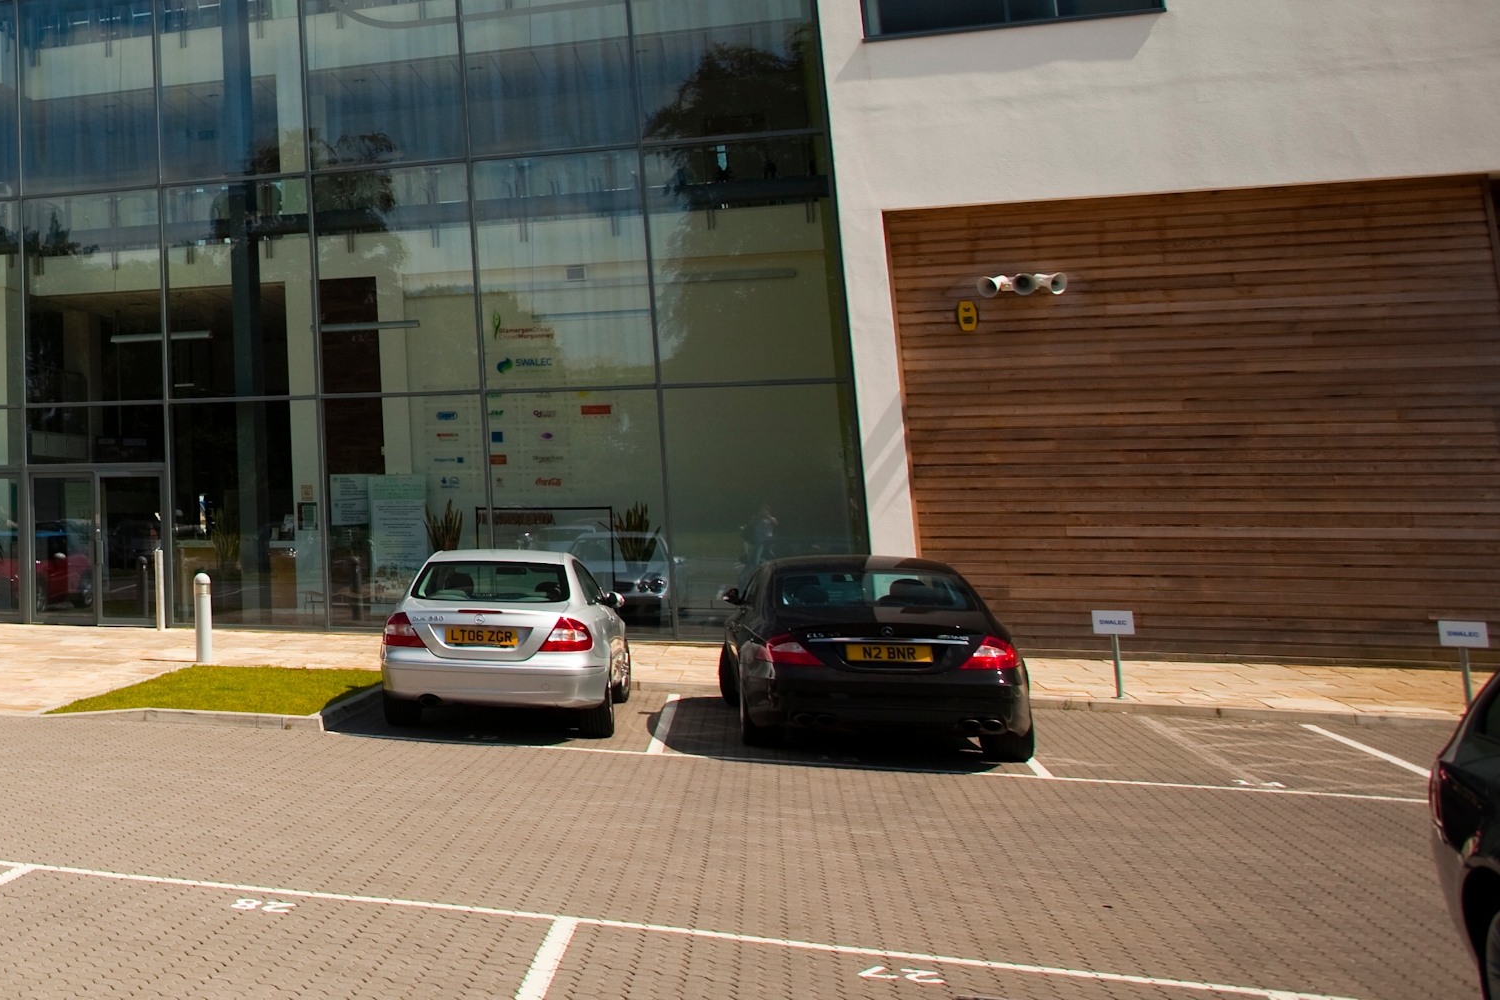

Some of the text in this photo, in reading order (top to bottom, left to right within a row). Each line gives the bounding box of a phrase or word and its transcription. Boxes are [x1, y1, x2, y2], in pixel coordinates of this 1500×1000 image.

[515, 357, 553, 367] SWALEC
[451, 629, 513, 643] LT06 ZGR
[1446, 630, 1480, 638] SWALEC
[862, 646, 916, 660] N2 BNR
[230, 898, 297, 913] 28
[857, 966, 946, 984] 27
